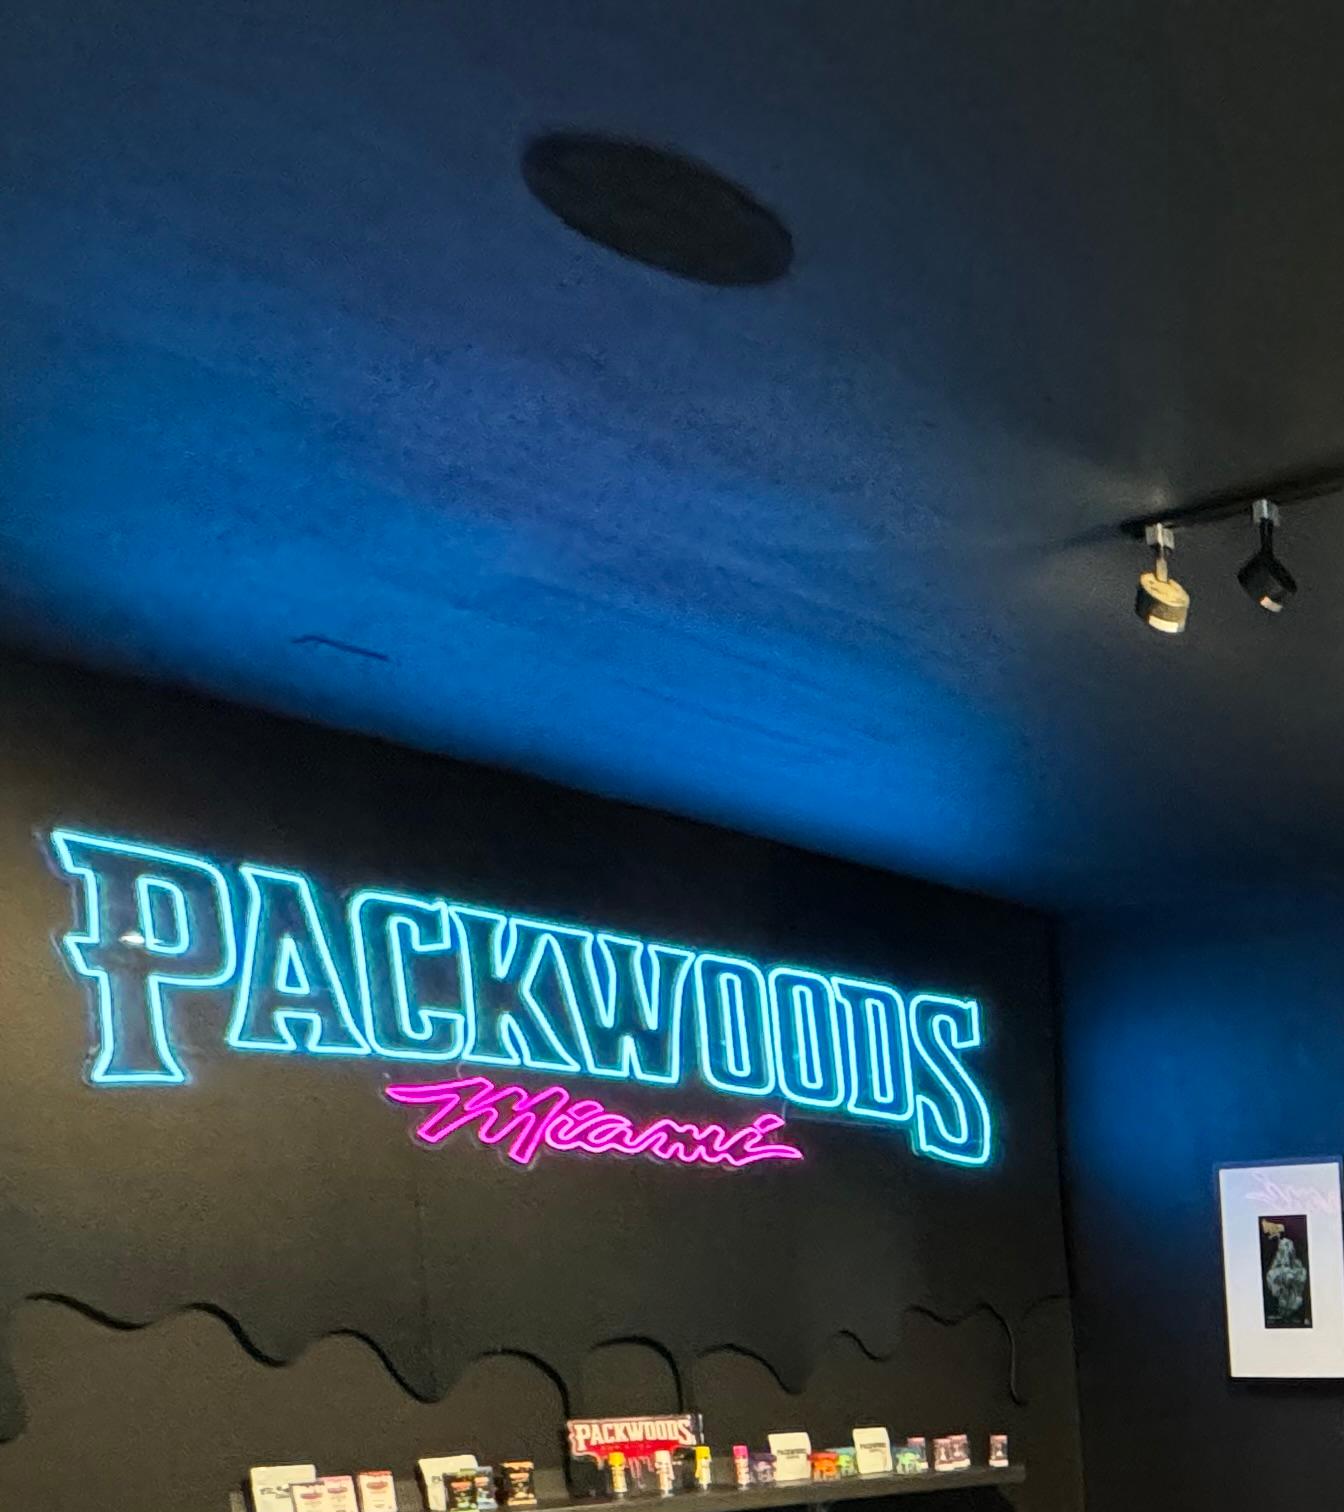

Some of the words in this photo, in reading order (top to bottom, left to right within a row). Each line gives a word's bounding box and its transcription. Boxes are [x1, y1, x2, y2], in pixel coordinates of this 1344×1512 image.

[52, 829, 992, 1168] PACKWOODS
[384, 1075, 804, 1167] Miami
[574, 1419, 697, 1452] PACKWOODS
